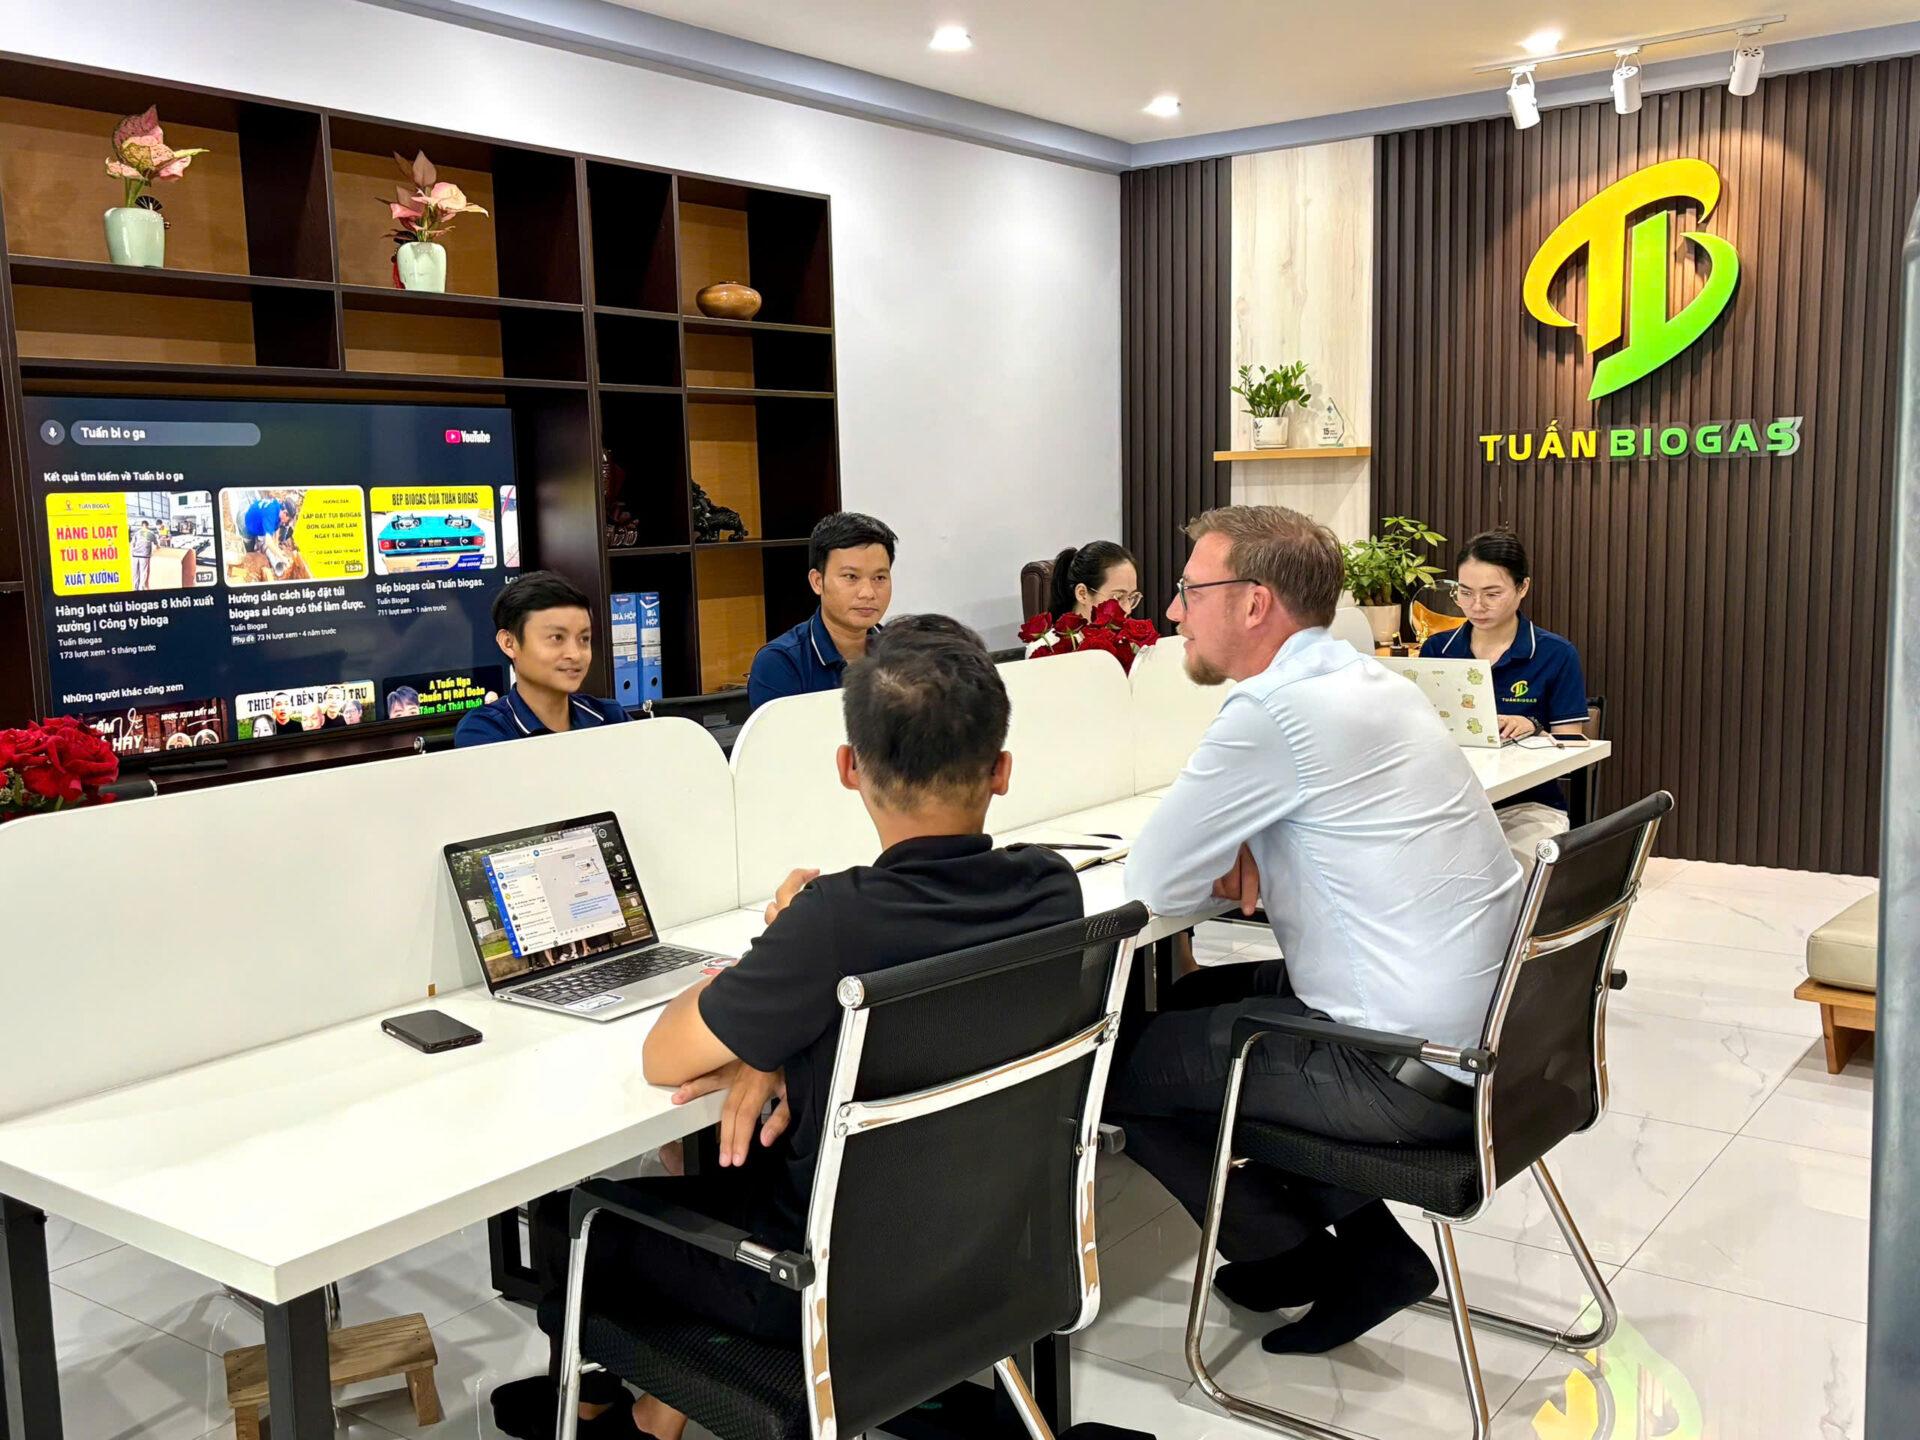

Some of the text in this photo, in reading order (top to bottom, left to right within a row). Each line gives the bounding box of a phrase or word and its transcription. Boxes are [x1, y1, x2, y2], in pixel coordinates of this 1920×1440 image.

[80, 426, 109, 439] Tuấn
[123, 430, 130, 438] o
[132, 430, 146, 441] ga
[460, 430, 491, 443] YouTube
[1479, 418, 1799, 462] TUẤN BIOGAS
[44, 471, 60, 482] Kết
[133, 470, 155, 481] Tuấn
[174, 474, 184, 482] ga
[405, 493, 427, 505] BIOGAS
[458, 492, 479, 504] BIOGAS
[82, 548, 89, 560] 8
[376, 578, 485, 595] Bếp biogas của Tuấn biogas.
[228, 592, 260, 605] Hướng
[279, 589, 301, 600] cách
[317, 587, 332, 598] đặt
[333, 586, 345, 596] túi
[55, 594, 214, 618] Hàng loạt túi biogas 8 khối xuất
[229, 608, 261, 620] biogas
[272, 605, 294, 617] cũng
[295, 602, 307, 613] có
[324, 601, 340, 611] làm
[341, 600, 366, 611] được.
[57, 620, 91, 633] xưởng
[99, 618, 127, 630] Công
[128, 617, 138, 628] ty
[141, 615, 169, 627] bioga
[247, 623, 268, 631] Biogas
[58, 637, 102, 646] Tuấn Biogas
[232, 636, 245, 644] Phụ
[272, 632, 284, 640] lượt
[60, 651, 74, 660] 173
[75, 650, 90, 658] lượt
[111, 647, 117, 655] 5
[117, 646, 137, 655] tháng
[138, 644, 157, 653] trước
[429, 676, 471, 690] A Tuấn Nga
[63, 683, 184, 704] Những người khác cũng xem
[443, 689, 452, 701] Bị
[419, 705, 435, 714] Tâm
